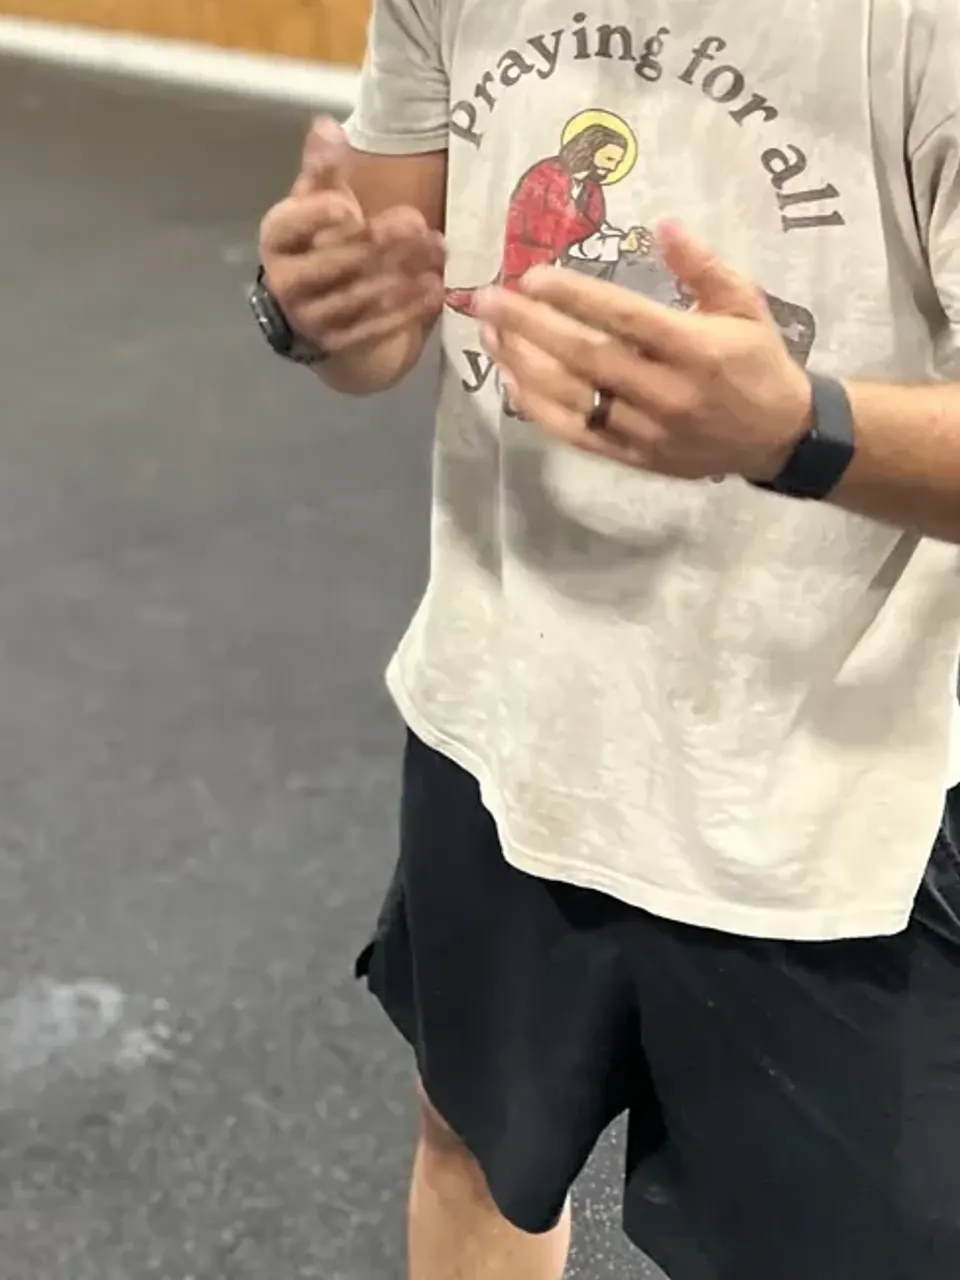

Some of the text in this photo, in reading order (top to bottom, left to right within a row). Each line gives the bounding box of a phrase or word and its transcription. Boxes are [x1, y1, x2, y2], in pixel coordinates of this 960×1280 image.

[447, 11, 846, 233] praying for all
